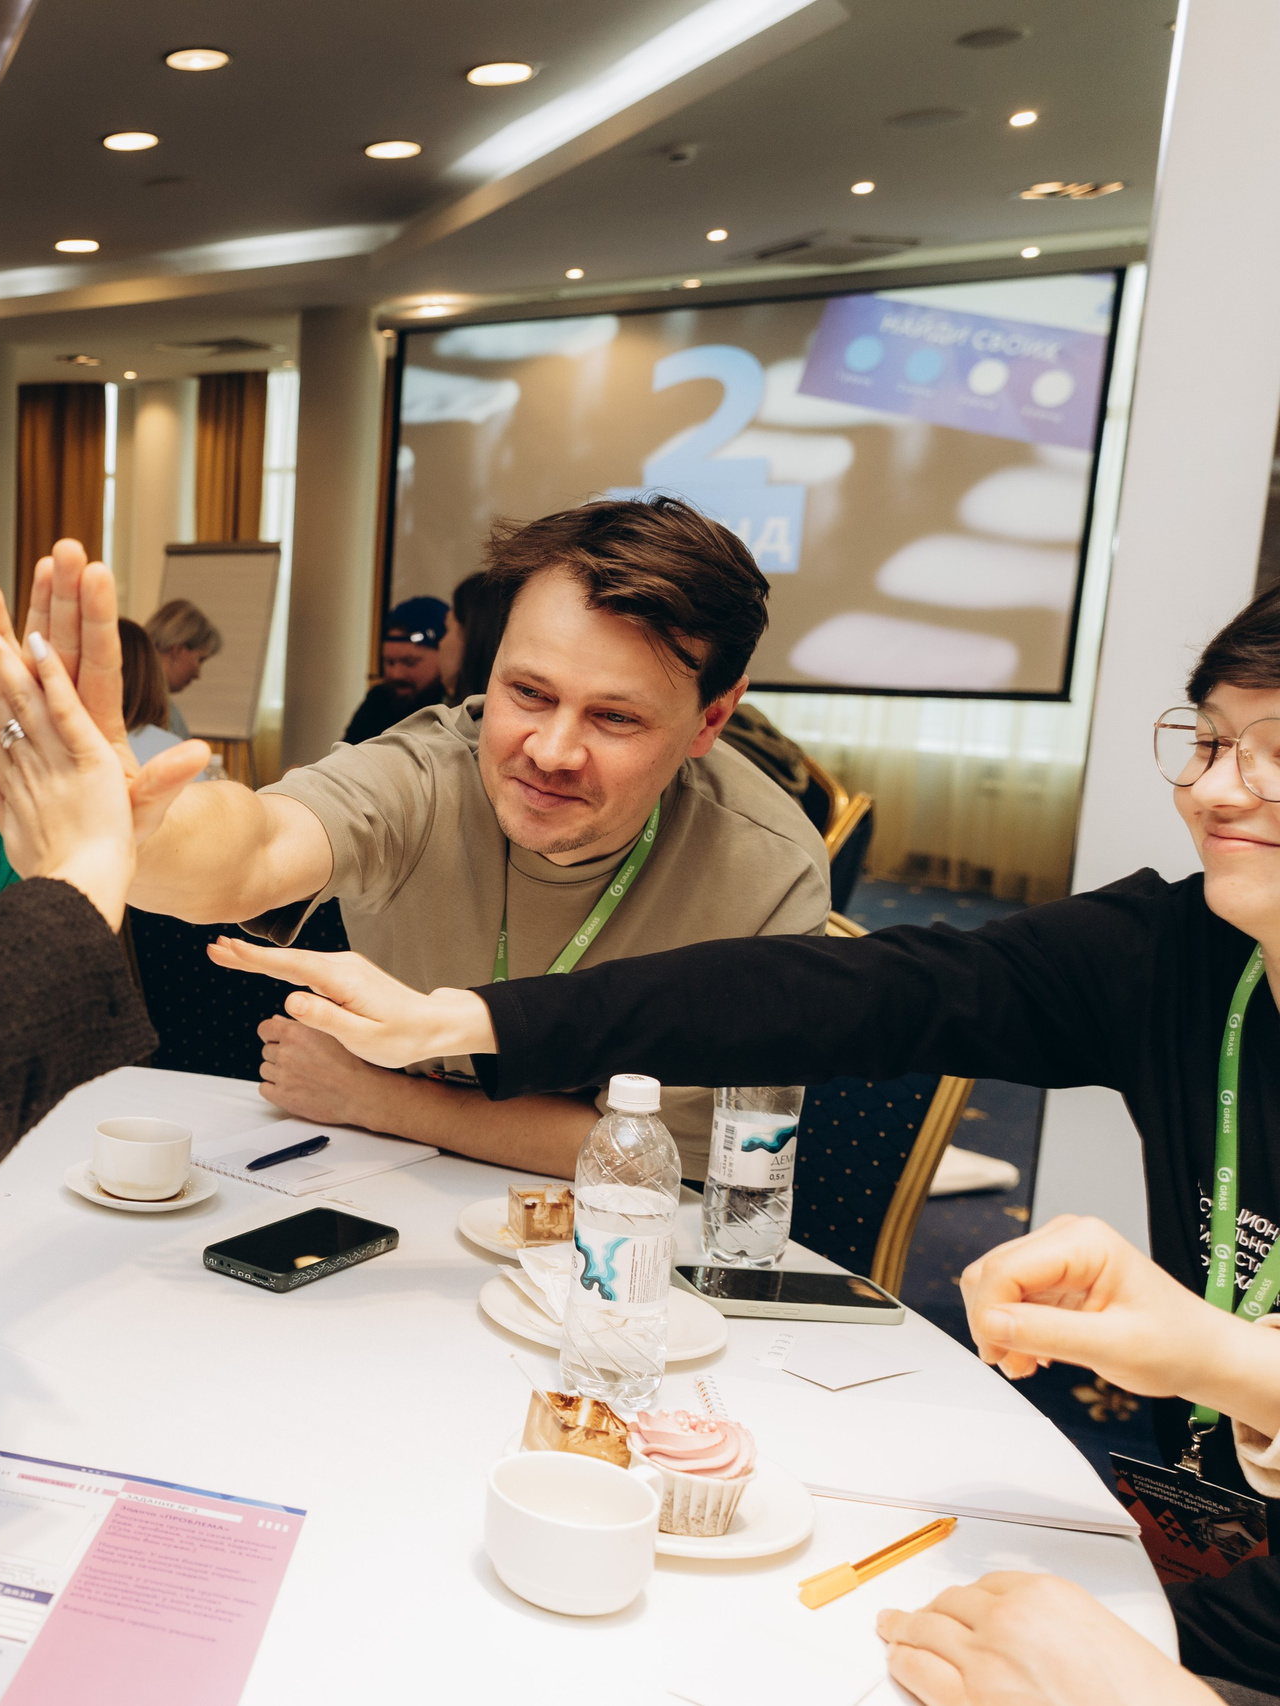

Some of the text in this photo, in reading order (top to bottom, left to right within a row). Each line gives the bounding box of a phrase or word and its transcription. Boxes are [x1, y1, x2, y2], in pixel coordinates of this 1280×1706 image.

[642, 344, 768, 486] 2
[620, 865, 635, 885] GRASS
[585, 916, 600, 936] GRASS
[1245, 960, 1263, 983] GRASS
[1226, 1030, 1236, 1057] GRASS
[1222, 1107, 1231, 1134] GRASS
[1218, 1185, 1227, 1211] GRASS
[1216, 1261, 1227, 1288] GRASS
[1254, 1278, 1272, 1302] GRASS
[125, 1494, 175, 1508] ЗАДАНИЕ
[1132, 1473, 1176, 1492] БОЛЬШАЯ
[1178, 1488, 1231, 1512] УРАЛЬСКАЯ
[1134, 1486, 1200, 1513] КОНФЕРЕНЦИЯ
[120, 1505, 157, 1517] Задача
[1185, 1497, 1220, 1515] БИЗНЕС
